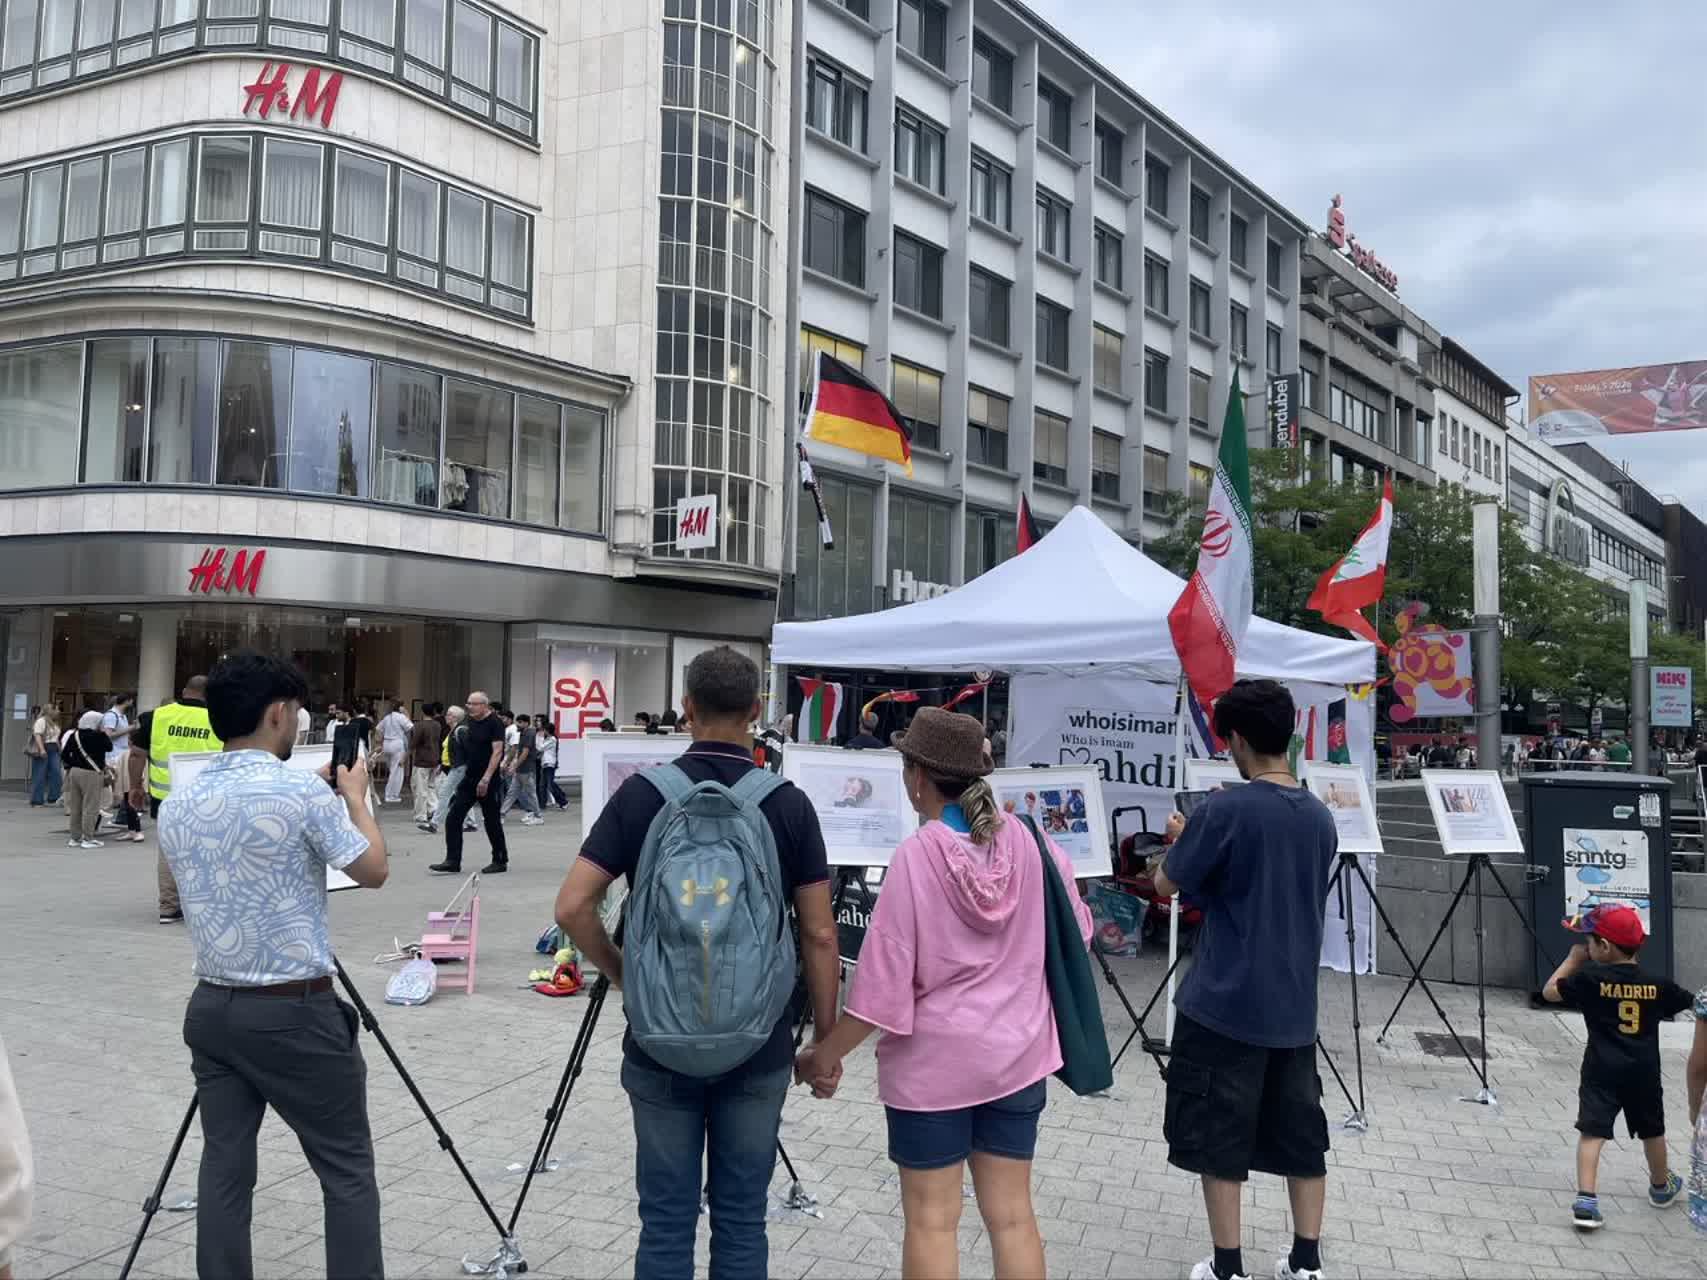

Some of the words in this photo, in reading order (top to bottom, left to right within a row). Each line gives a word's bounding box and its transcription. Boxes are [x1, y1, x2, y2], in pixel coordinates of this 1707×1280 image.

[243, 60, 343, 128] H&M
[679, 506, 710, 538] H&M
[188, 547, 266, 597] H&M
[168, 725, 210, 740] ORDNER
[1565, 849, 1626, 870] snntg
[1600, 982, 1657, 999] MADRID
[1618, 1000, 1639, 1034] 9
